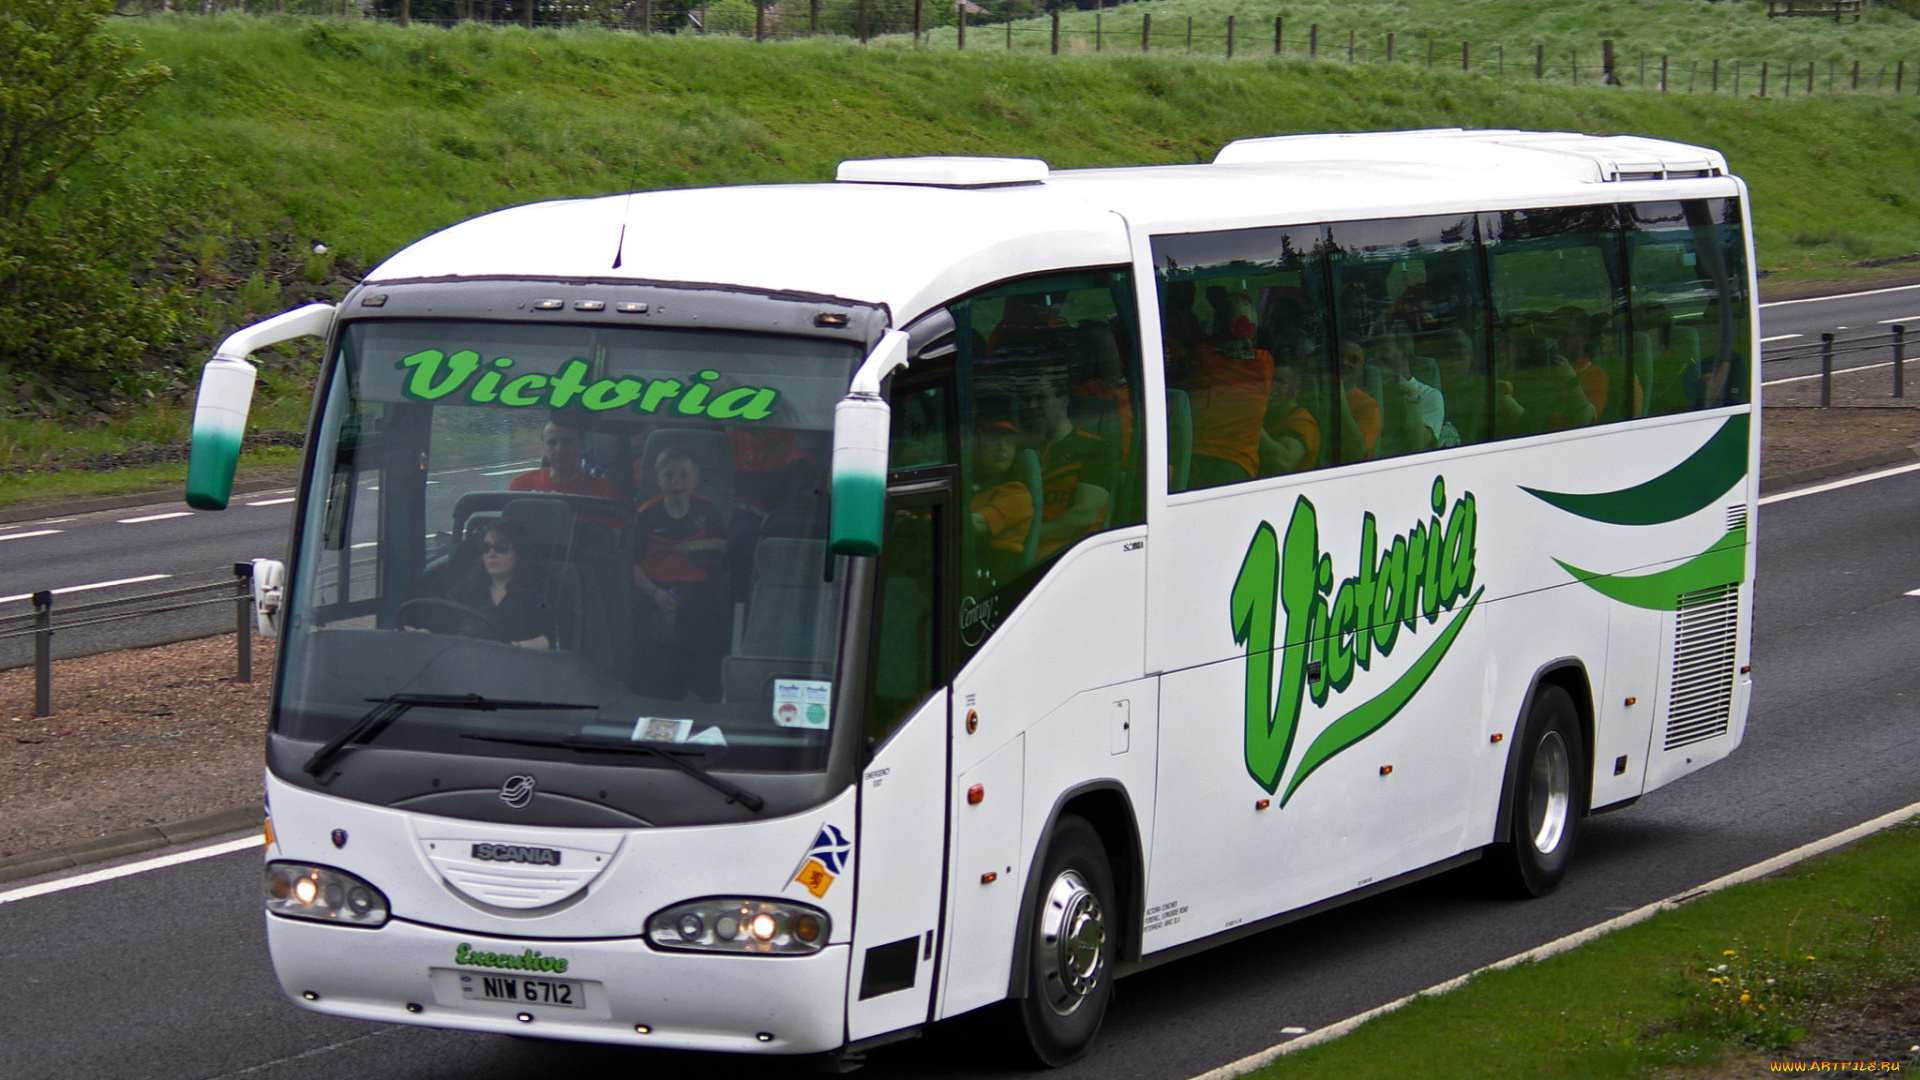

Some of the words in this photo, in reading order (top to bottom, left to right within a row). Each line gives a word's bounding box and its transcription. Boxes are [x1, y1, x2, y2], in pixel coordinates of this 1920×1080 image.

[395, 348, 782, 423] Victoria
[1230, 475, 1478, 797] Victoria
[473, 843, 562, 866] SCANIA
[455, 942, 569, 973] Executive
[483, 977, 517, 999] NIW
[523, 981, 573, 1005] 6712
